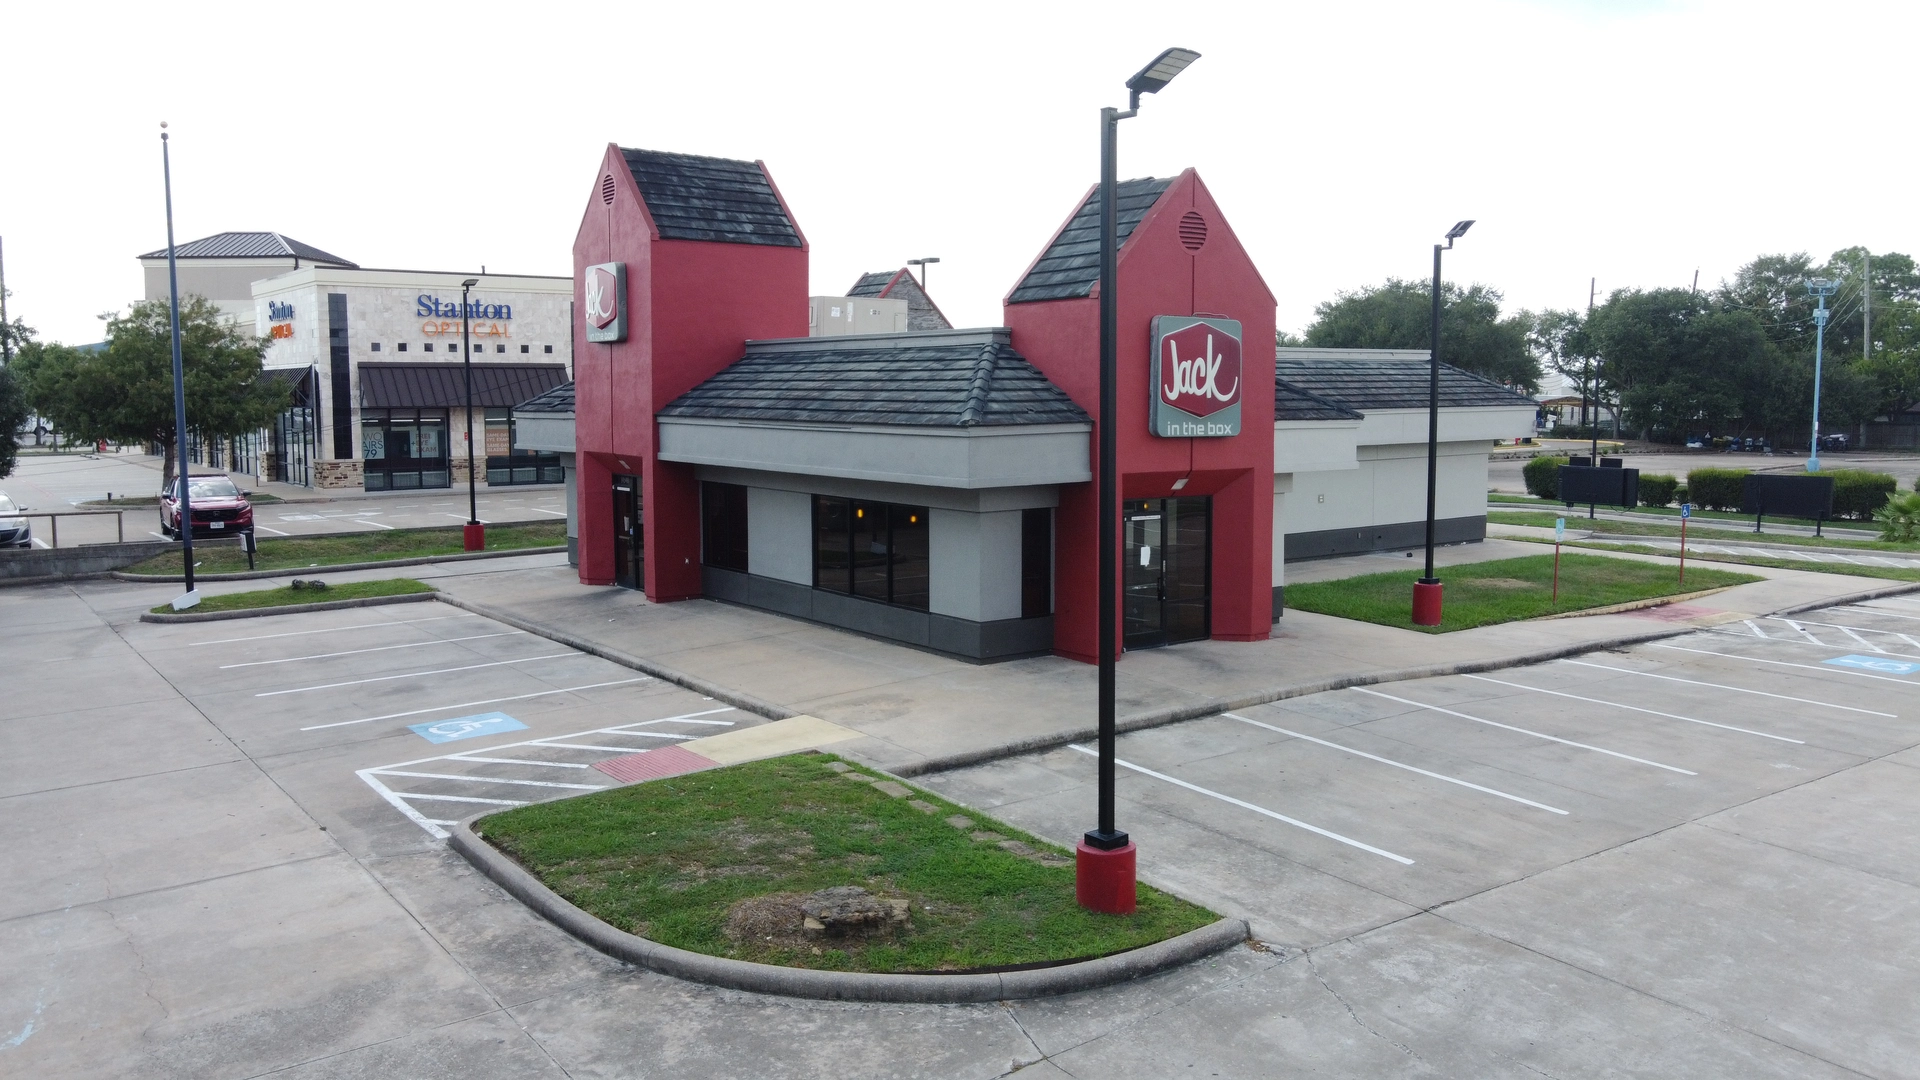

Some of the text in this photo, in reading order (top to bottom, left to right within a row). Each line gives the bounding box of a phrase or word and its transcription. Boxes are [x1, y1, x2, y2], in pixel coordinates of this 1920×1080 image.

[417, 294, 513, 320] Stanton
[422, 320, 513, 338] OPTCAL
[1164, 333, 1238, 402] Jack
[363, 431, 382, 440] WO
[1167, 421, 1232, 435] in the box
[363, 440, 383, 449] AIRS
